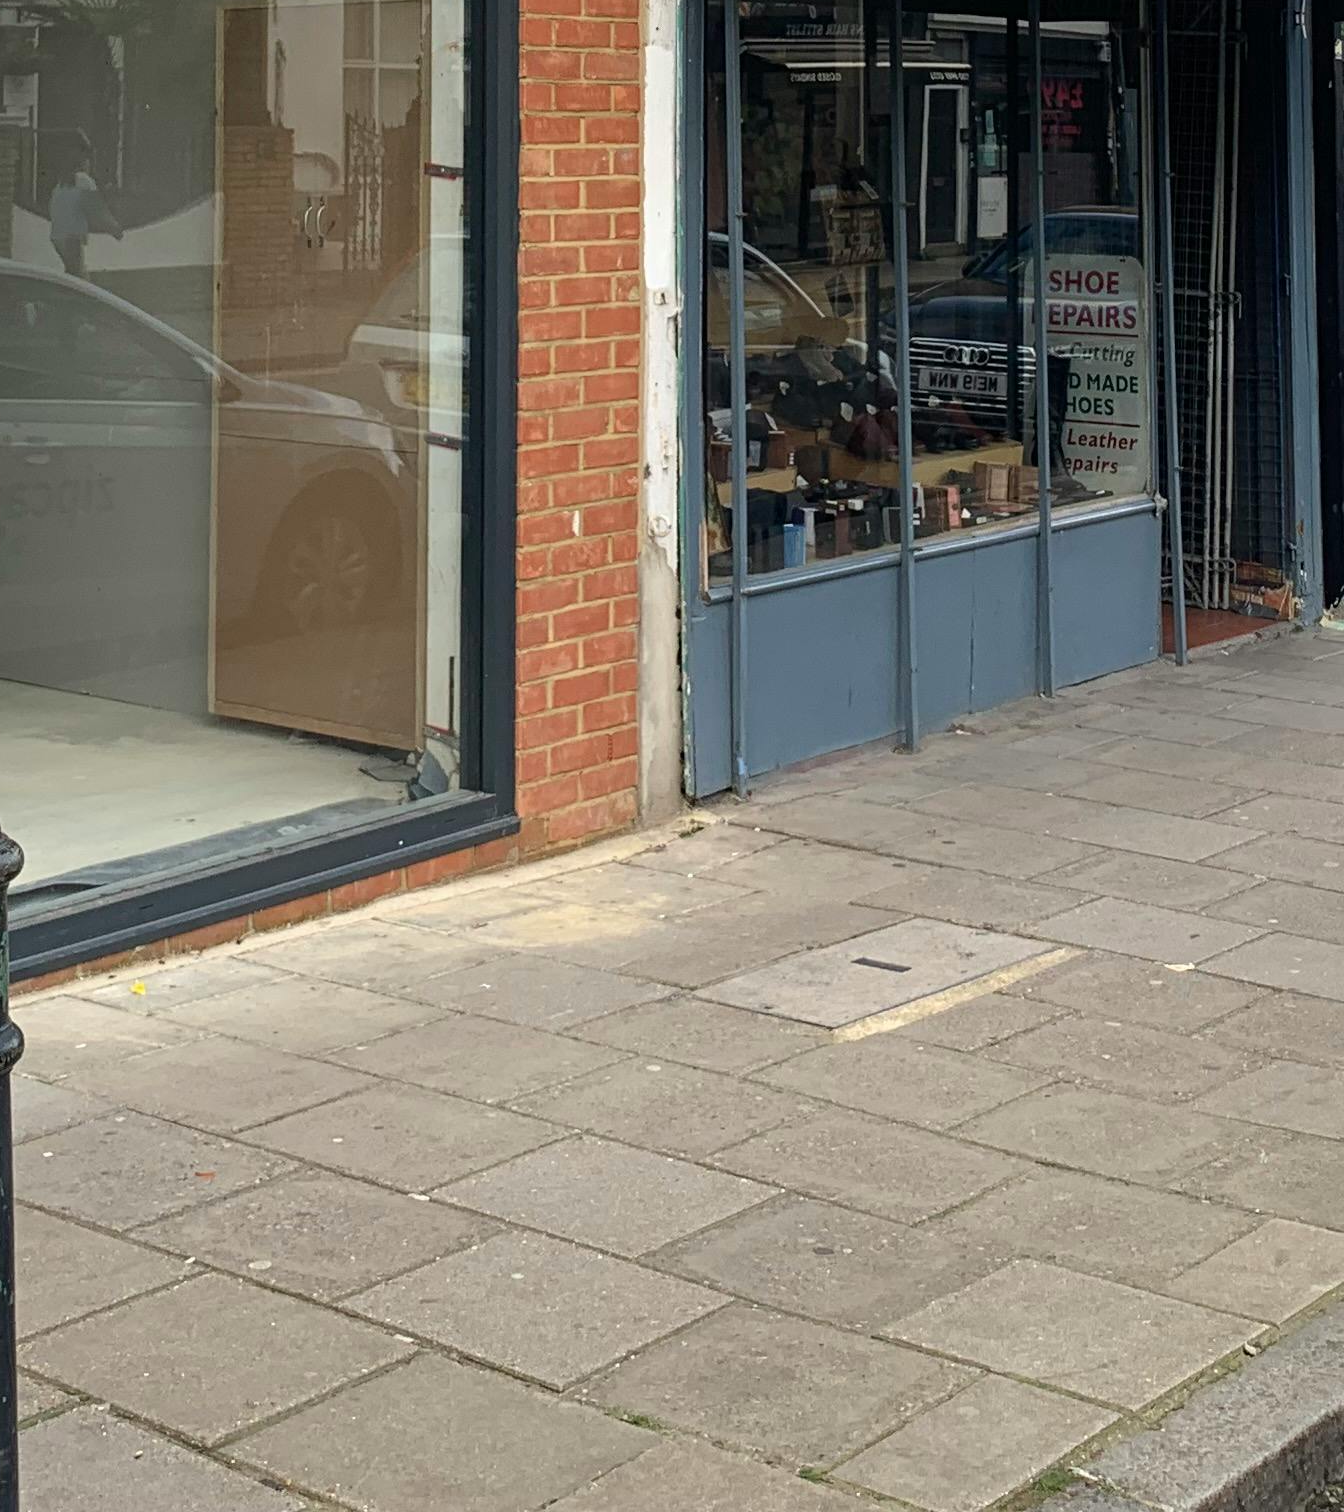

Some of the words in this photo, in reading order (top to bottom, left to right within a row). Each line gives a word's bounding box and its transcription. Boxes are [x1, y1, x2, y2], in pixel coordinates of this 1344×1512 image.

[1048, 269, 1120, 295] SHOE
[1032, 303, 1137, 330] EPAIRS
[1069, 342, 1136, 368] Cutting
[1086, 373, 1139, 394] MADE
[1065, 396, 1115, 416] HOES
[1066, 428, 1139, 451] Leather
[1064, 456, 1119, 476] epairs
